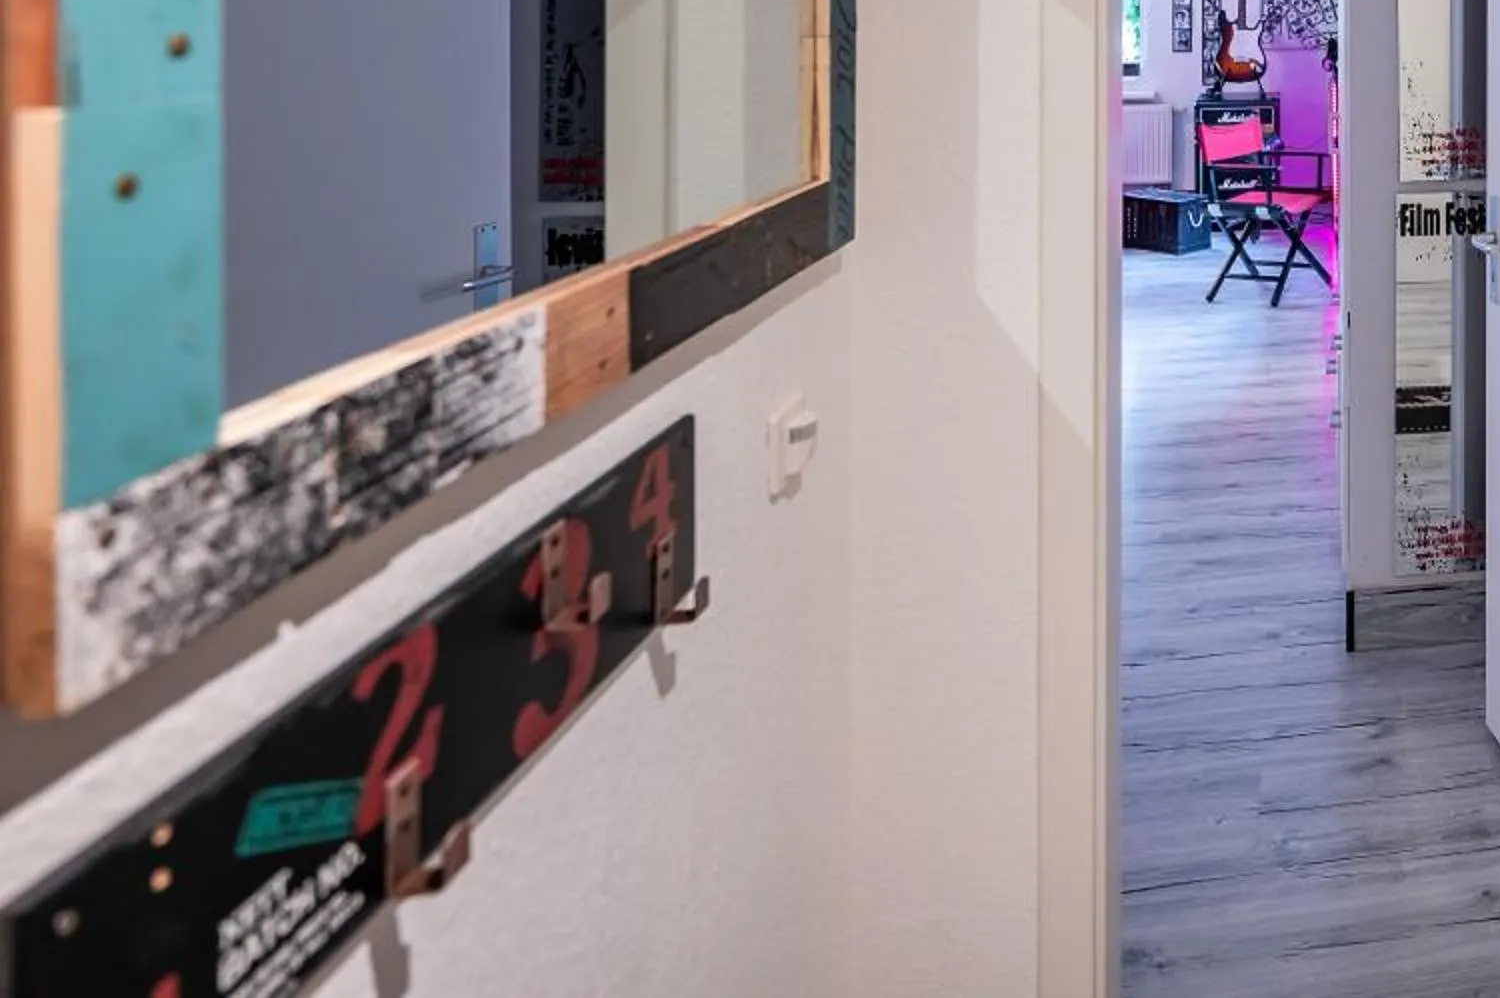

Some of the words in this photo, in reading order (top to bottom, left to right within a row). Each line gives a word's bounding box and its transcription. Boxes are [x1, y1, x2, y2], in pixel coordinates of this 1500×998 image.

[1400, 203, 1440, 237] Film
[352, 620, 444, 838] 2
[512, 517, 599, 759] 3
[630, 444, 678, 564] 4
